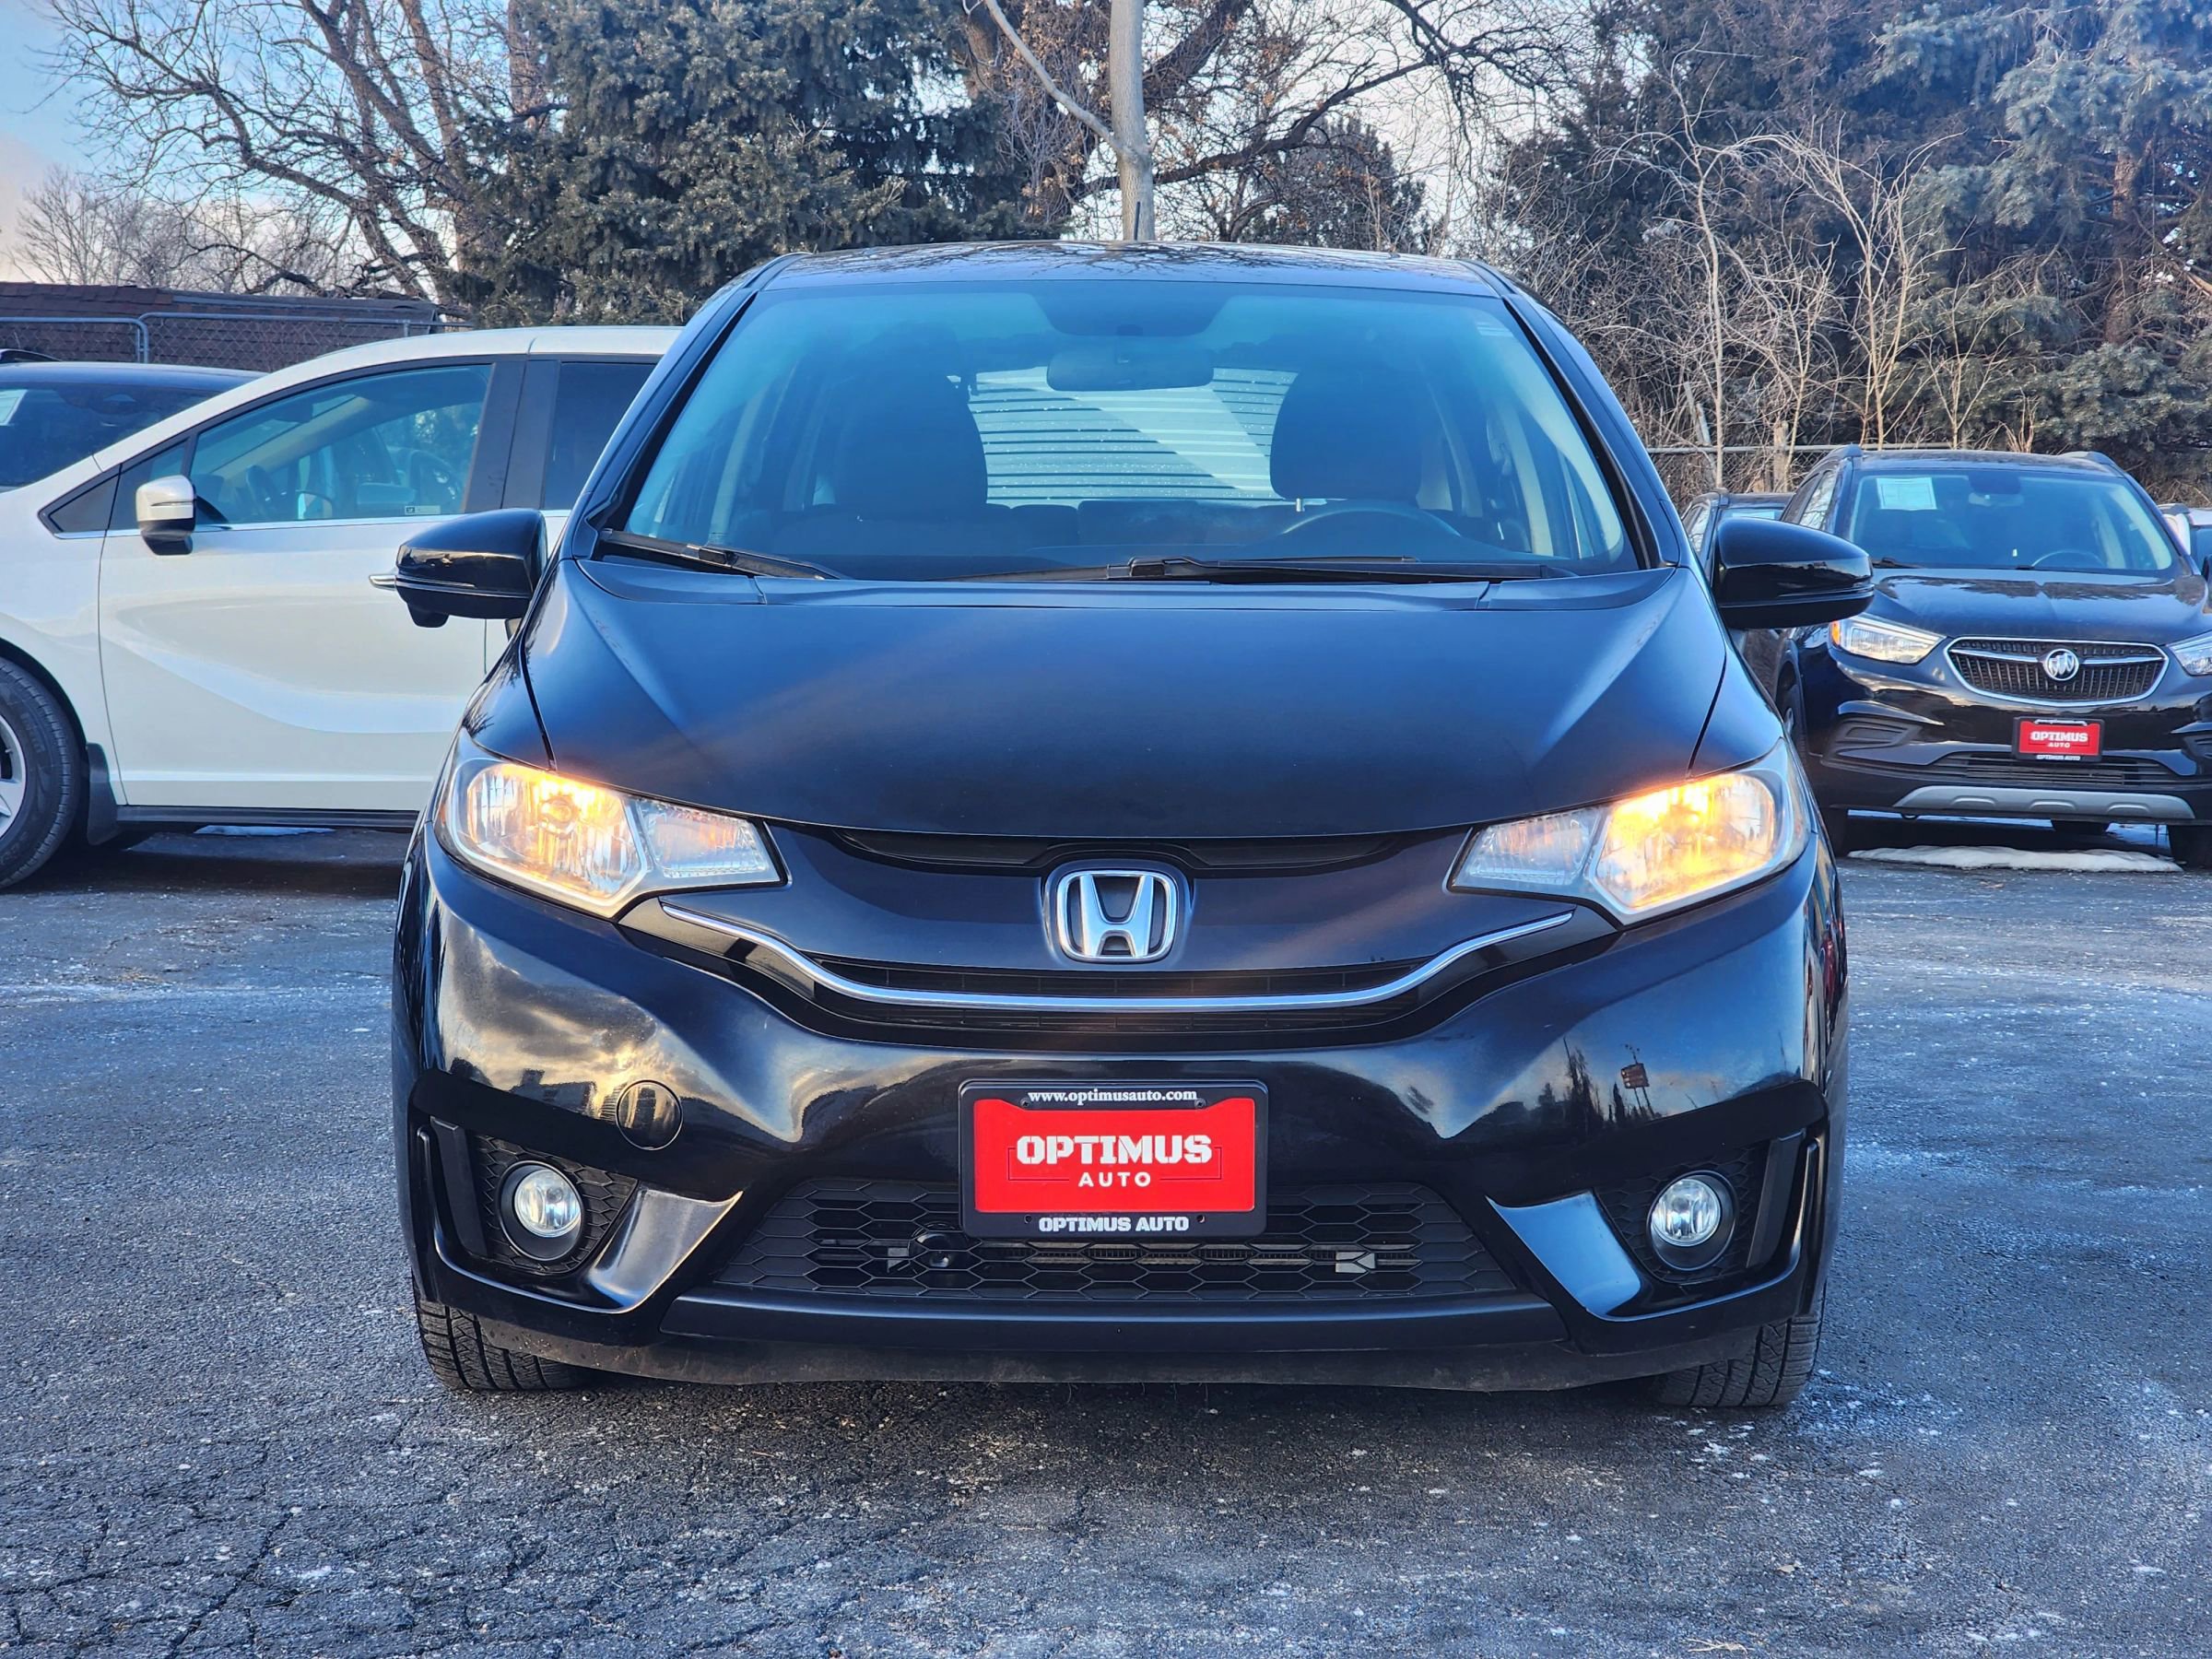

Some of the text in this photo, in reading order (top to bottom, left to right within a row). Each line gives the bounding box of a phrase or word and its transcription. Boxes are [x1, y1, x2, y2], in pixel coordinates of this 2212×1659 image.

[2030, 731, 2088, 742] OPTIMUS
[1028, 1088, 1197, 1105] www.optimusauto.com
[1017, 1135, 1212, 1165] OPTIMUS
[1077, 1171, 1151, 1187] AUTO
[1039, 1217, 1189, 1232] OPTIMUS AUTO
